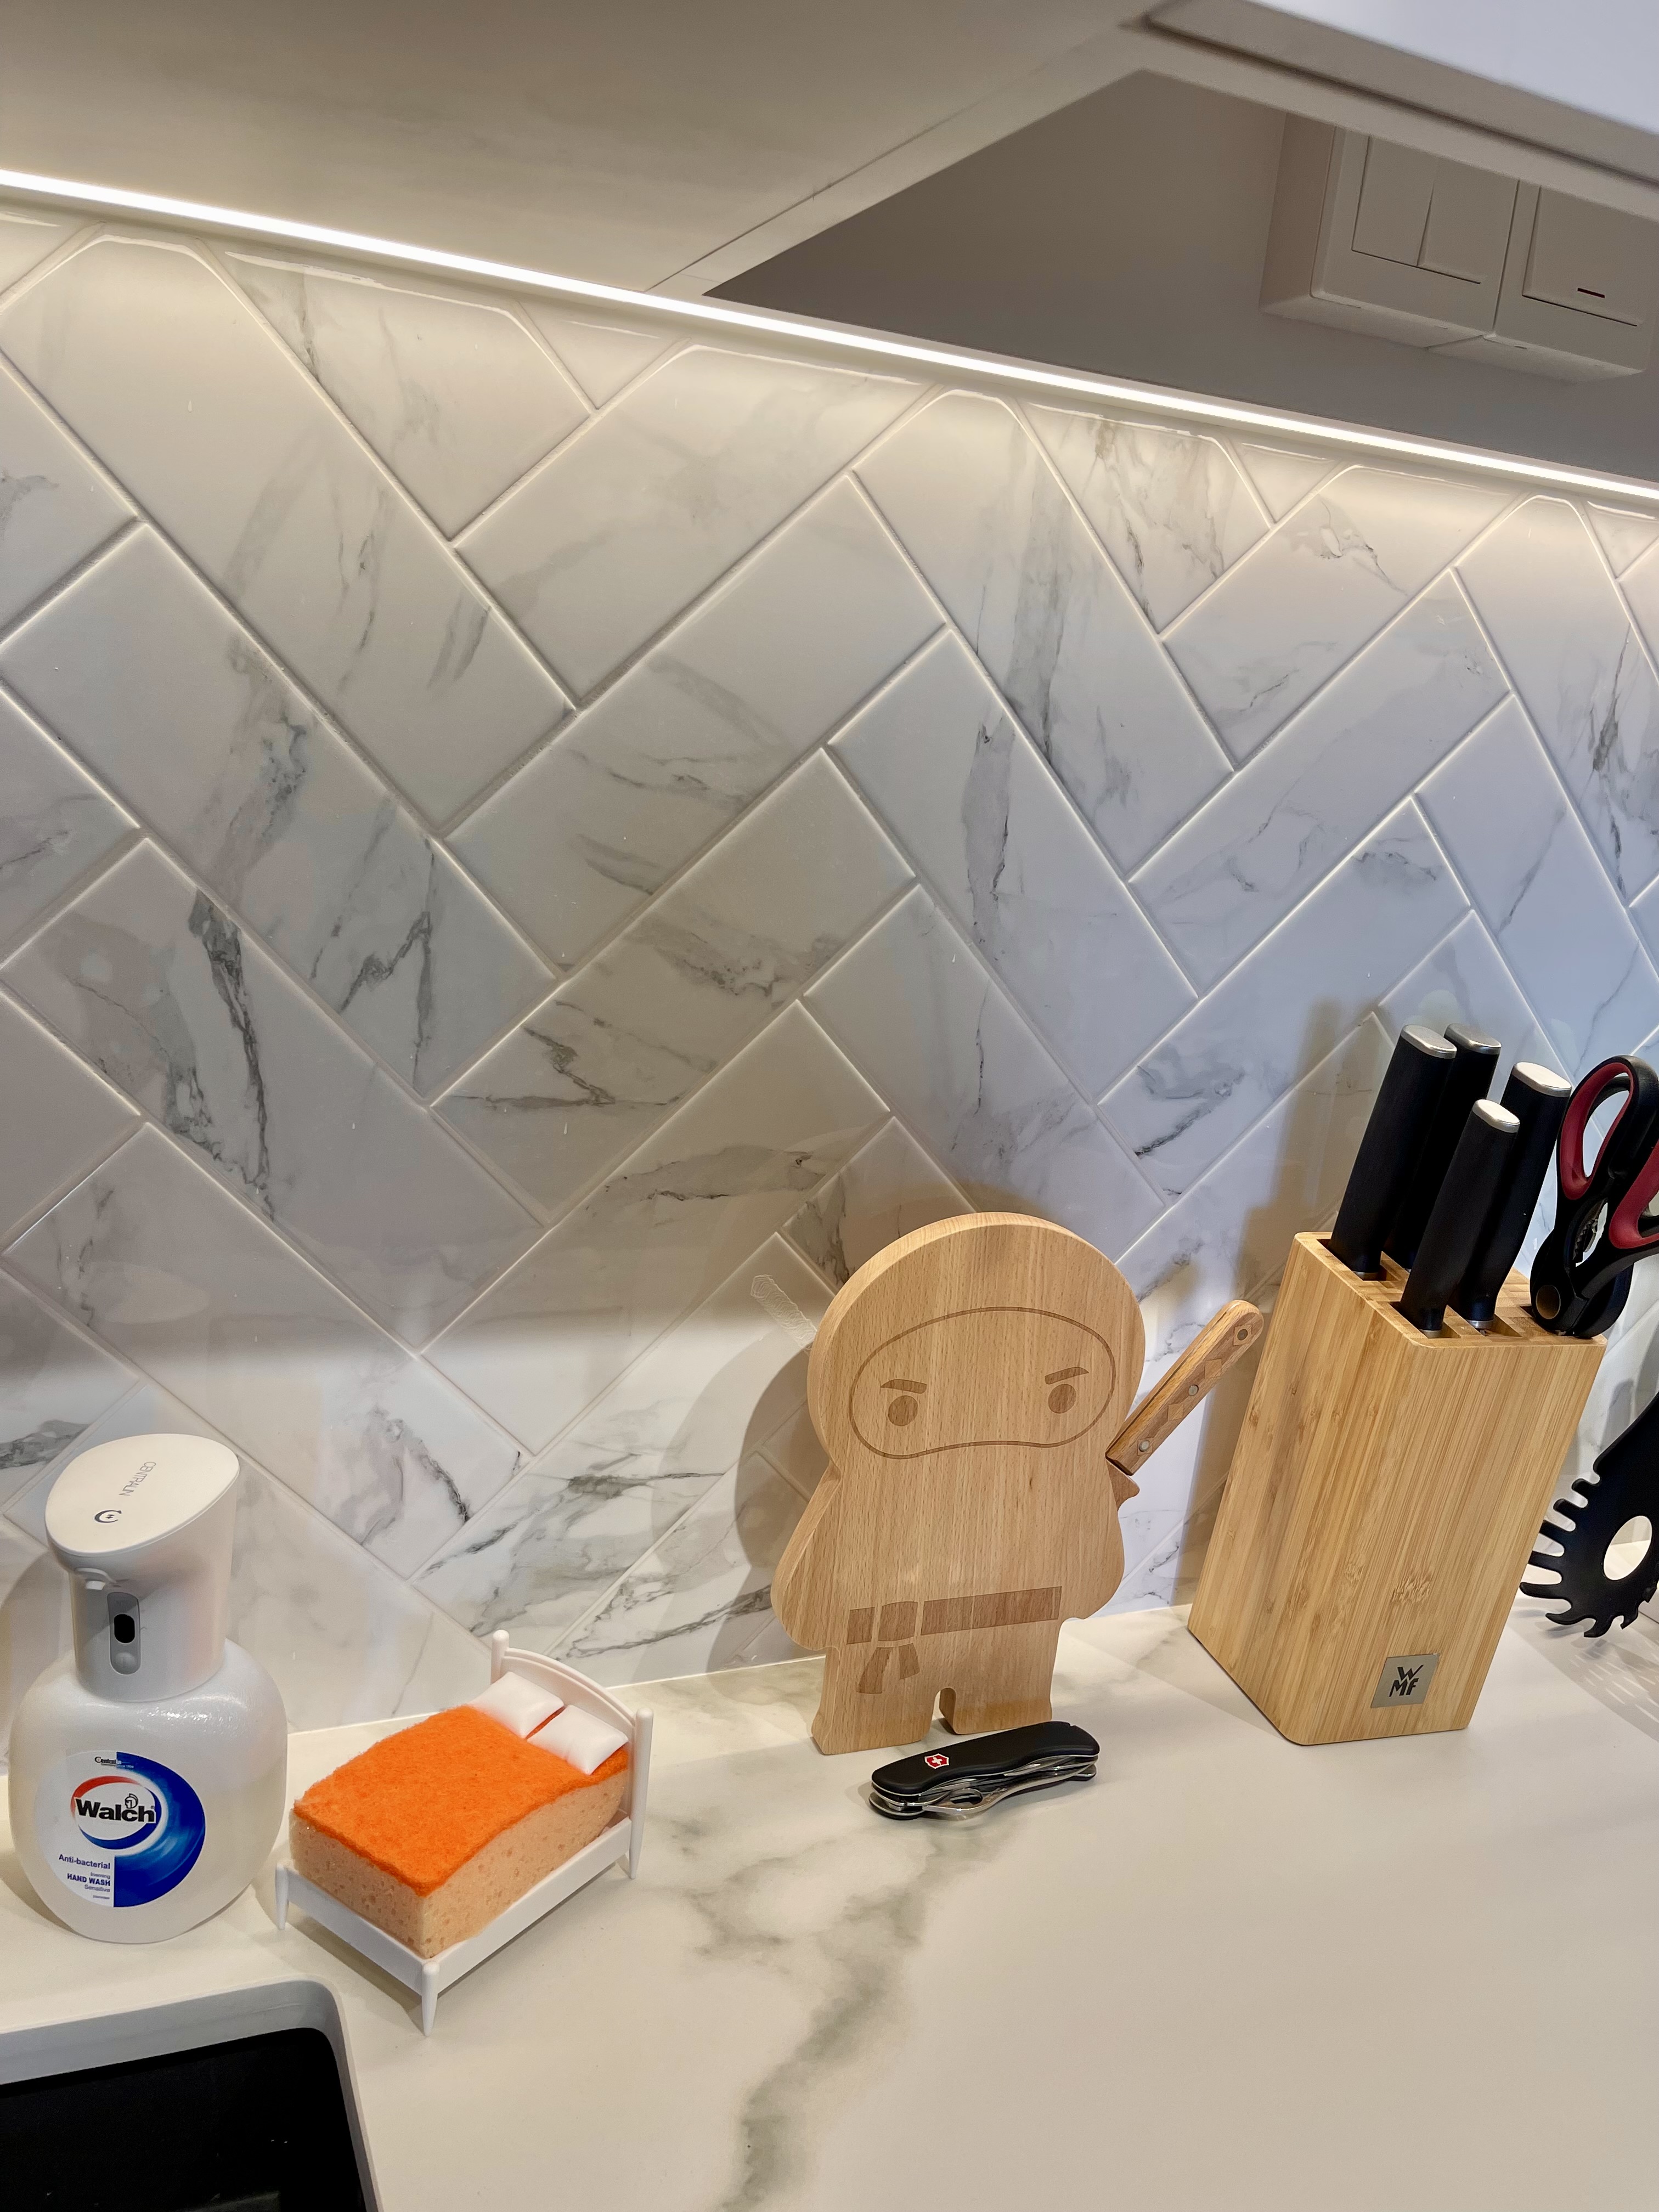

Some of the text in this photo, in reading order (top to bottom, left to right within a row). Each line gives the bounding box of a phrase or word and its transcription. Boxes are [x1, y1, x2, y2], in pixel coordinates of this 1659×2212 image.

[119, 1462, 156, 1496] CENTRALIN
[76, 1798, 155, 1822] Walch
[59, 1854, 110, 1869] Anti-bacterial
[67, 1873, 110, 1886] HAND WASH
